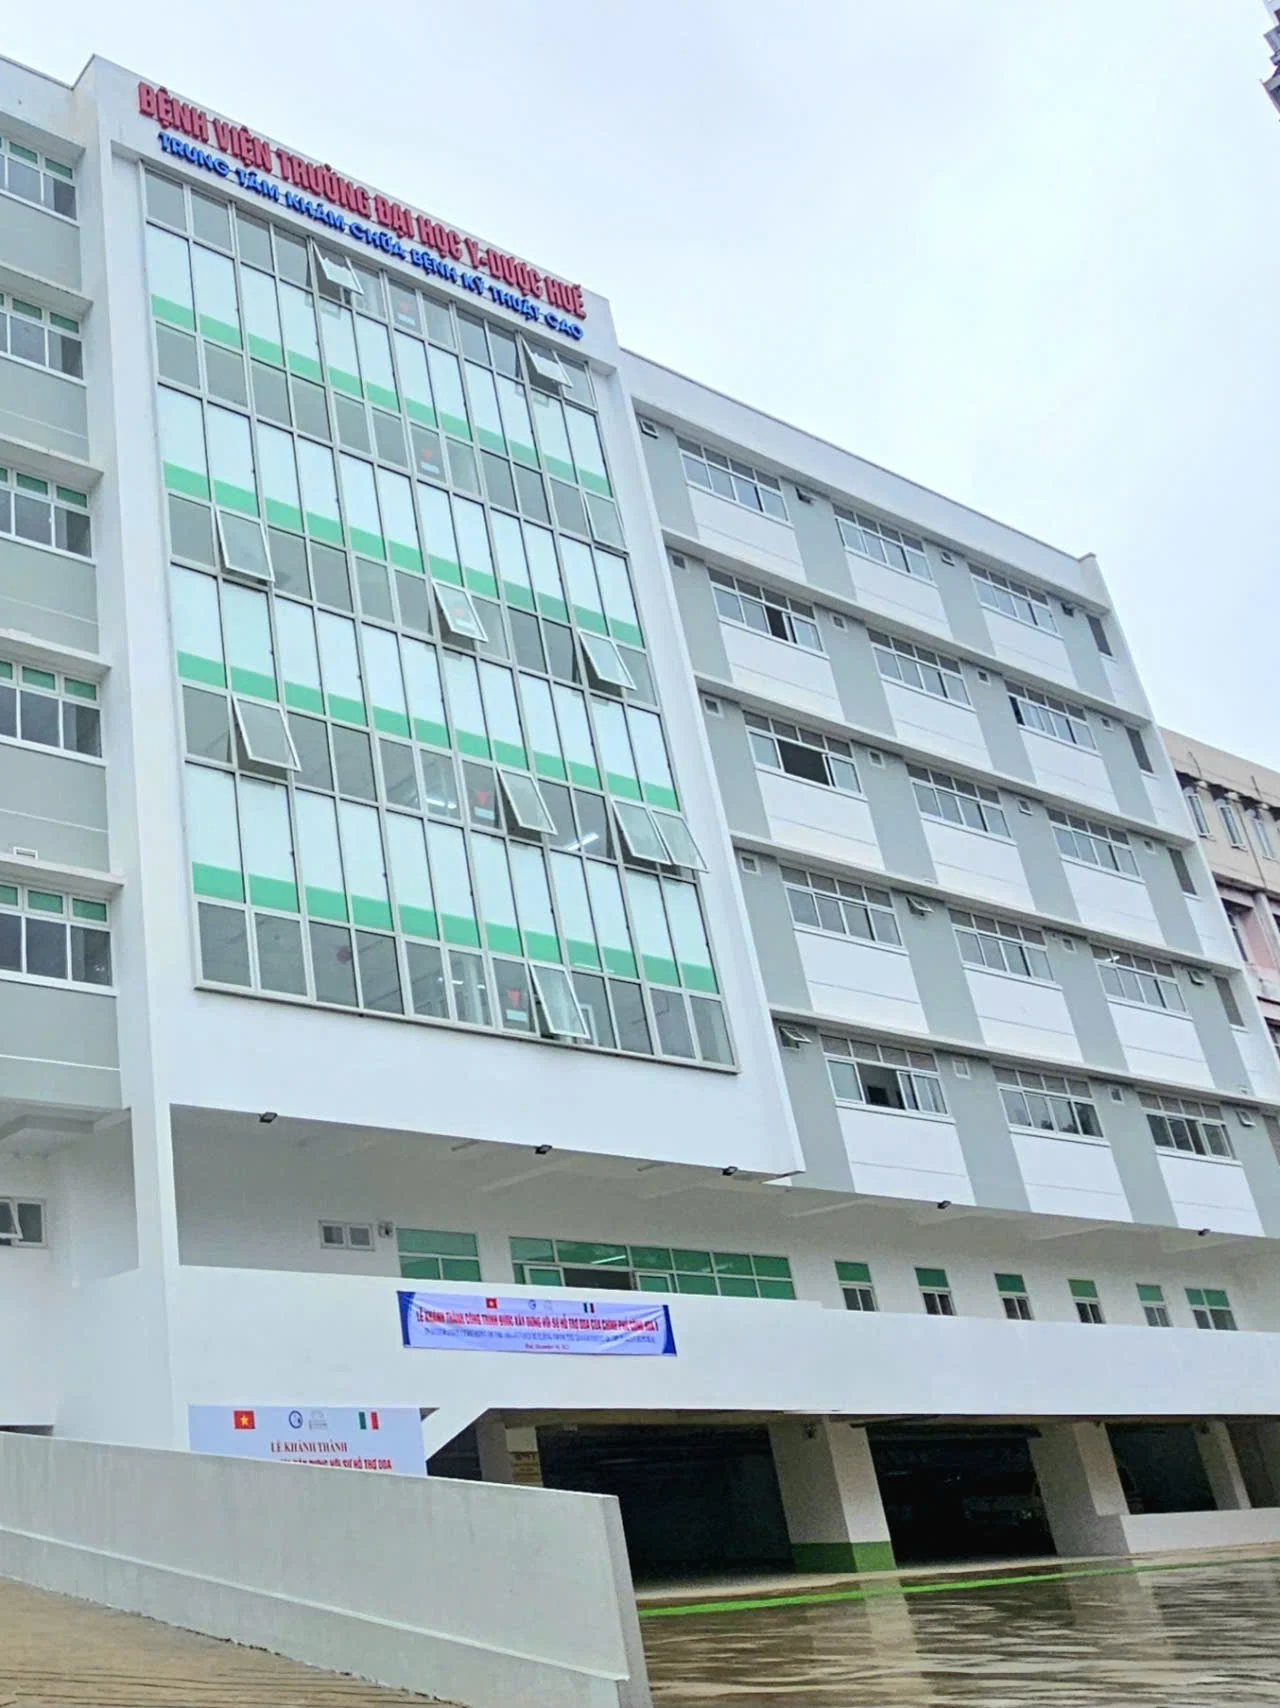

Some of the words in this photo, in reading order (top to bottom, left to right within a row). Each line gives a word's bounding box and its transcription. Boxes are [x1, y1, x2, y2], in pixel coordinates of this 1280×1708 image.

[138, 81, 209, 143] BỆNH
[213, 118, 272, 173] VIỆN
[275, 148, 372, 218] TRƯỜNG
[374, 193, 415, 239] ĐẠI
[416, 214, 463, 261] HỌC
[544, 275, 587, 320] HUẾ
[158, 131, 231, 177] TRUNG
[235, 168, 280, 203] TÂM
[285, 191, 345, 232] KHÁM
[349, 221, 406, 260] CHỮA
[410, 248, 457, 284] BỆNH
[488, 285, 540, 321] THUẬT
[543, 311, 584, 341] CAO
